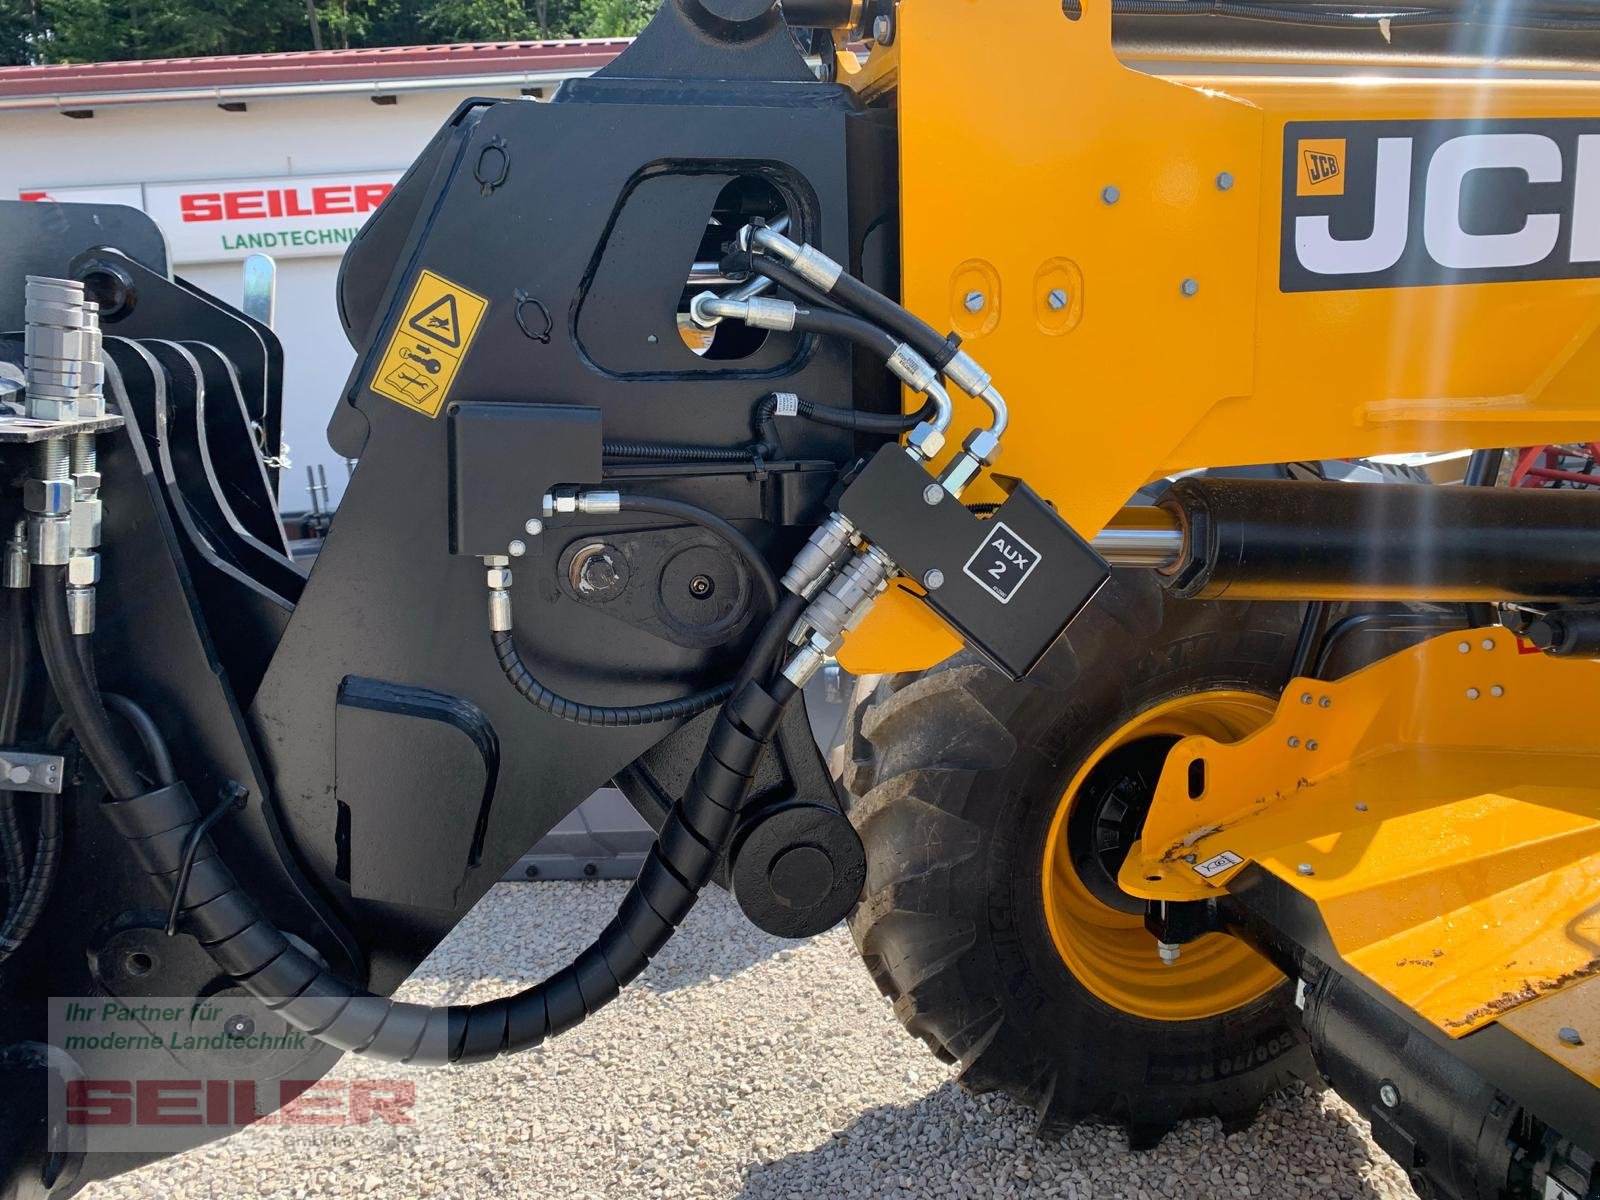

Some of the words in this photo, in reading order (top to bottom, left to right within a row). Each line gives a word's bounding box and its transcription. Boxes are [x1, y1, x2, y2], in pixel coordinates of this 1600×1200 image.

[1310, 153, 1337, 181] JCB
[181, 184, 393, 221] SEILER
[1295, 133, 1600, 275] JC
[222, 227, 358, 250] LANDTECHNI
[991, 538, 1029, 570] AUX
[987, 560, 1007, 580] 2
